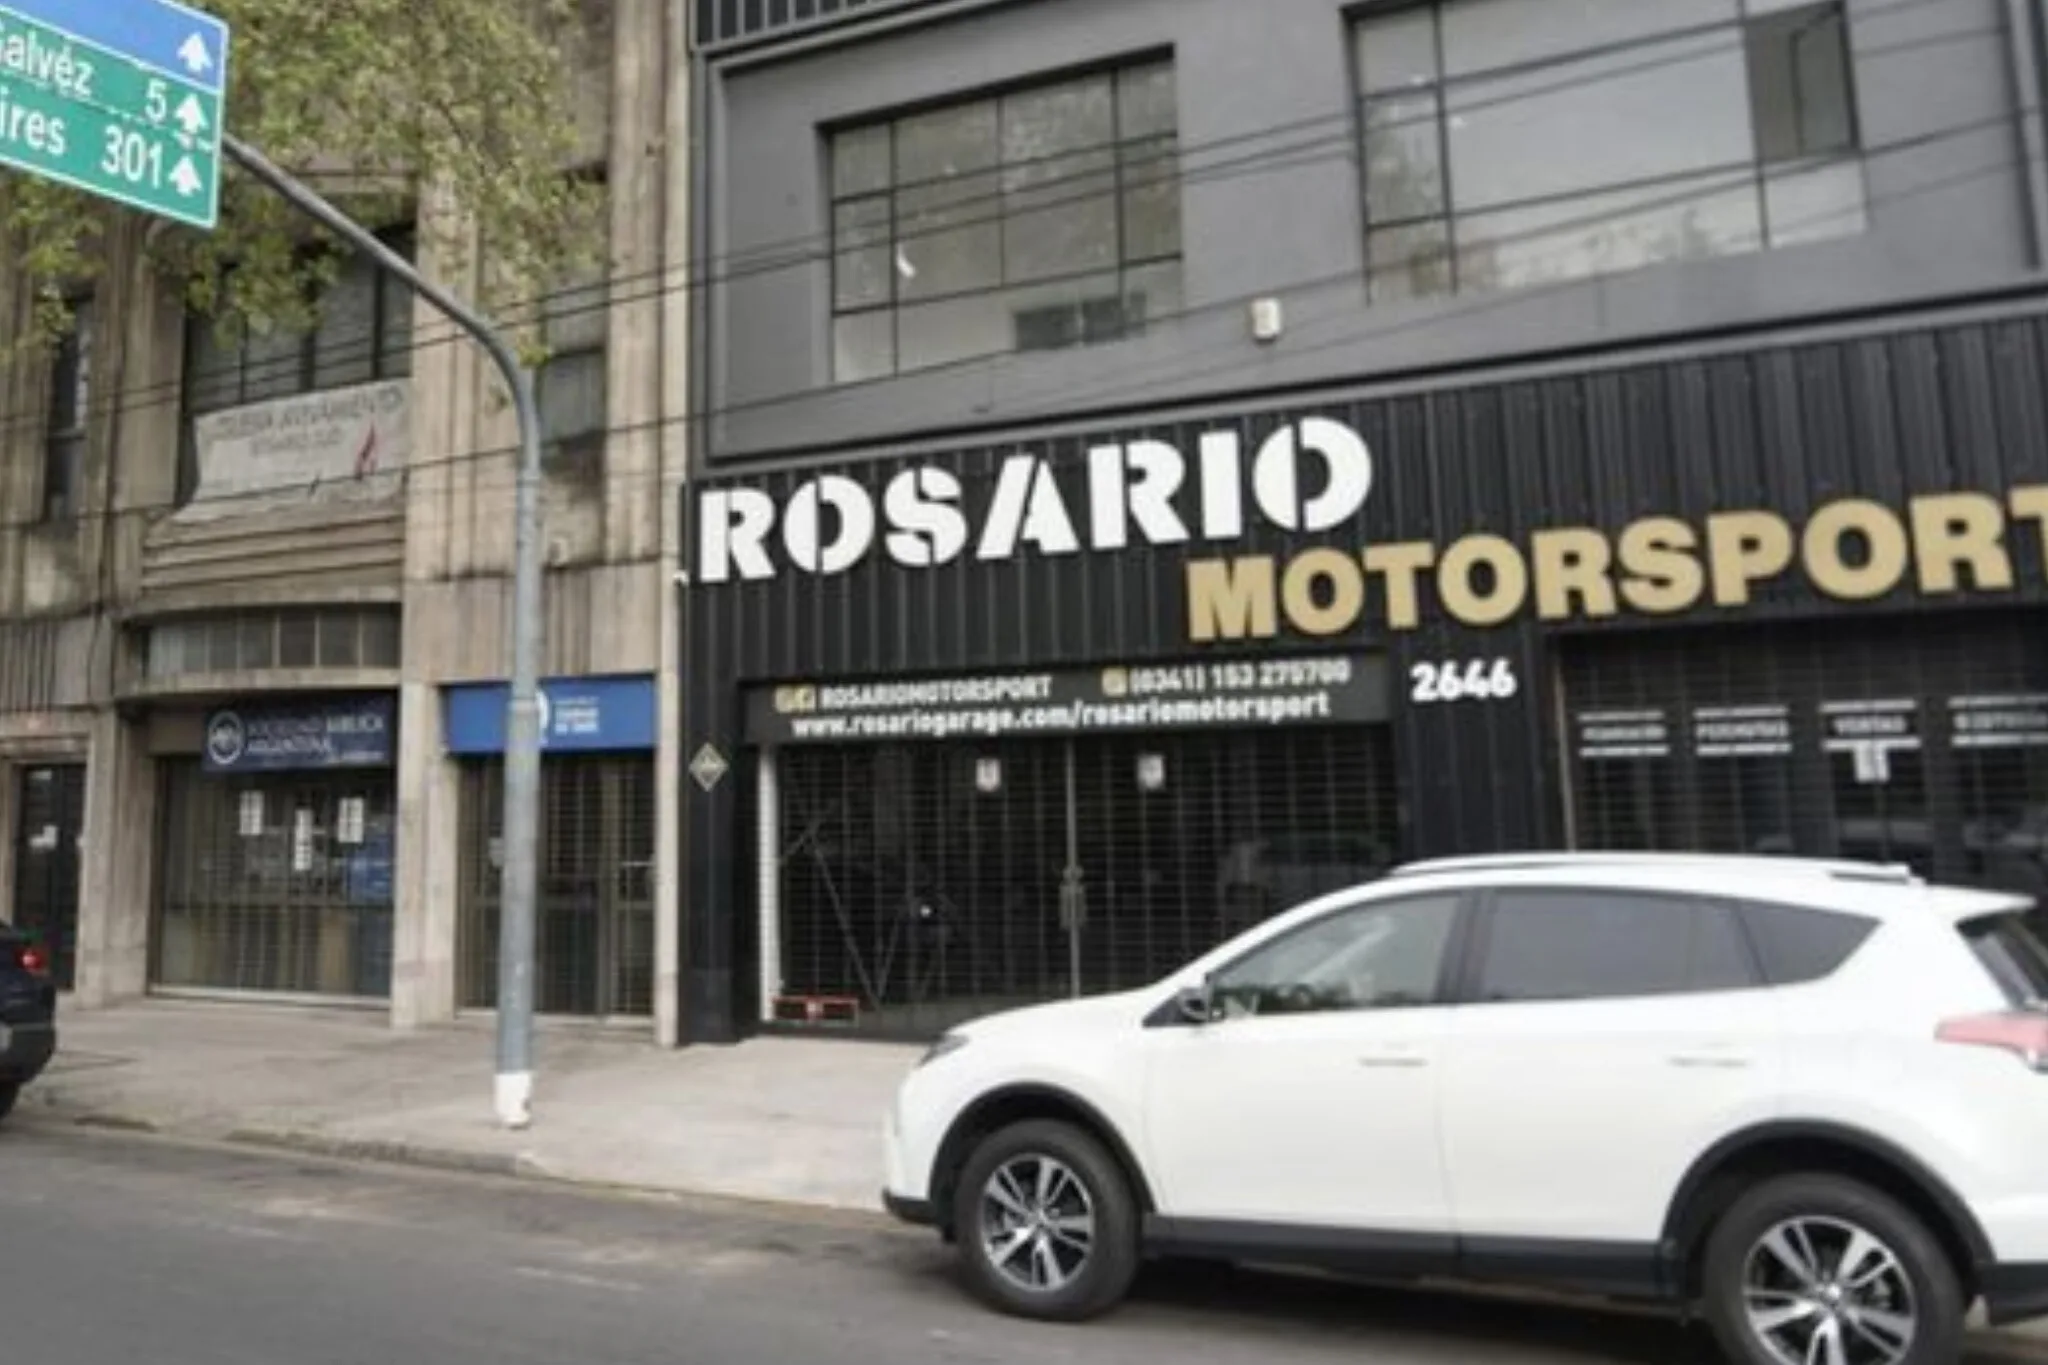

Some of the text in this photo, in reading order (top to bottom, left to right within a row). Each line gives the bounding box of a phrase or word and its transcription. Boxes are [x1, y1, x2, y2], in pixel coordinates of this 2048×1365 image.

[0, 23, 167, 122] alvéz 5
[102, 125, 163, 189] 301
[700, 416, 1372, 583] ROSARIO
[1410, 656, 1518, 702] 2646
